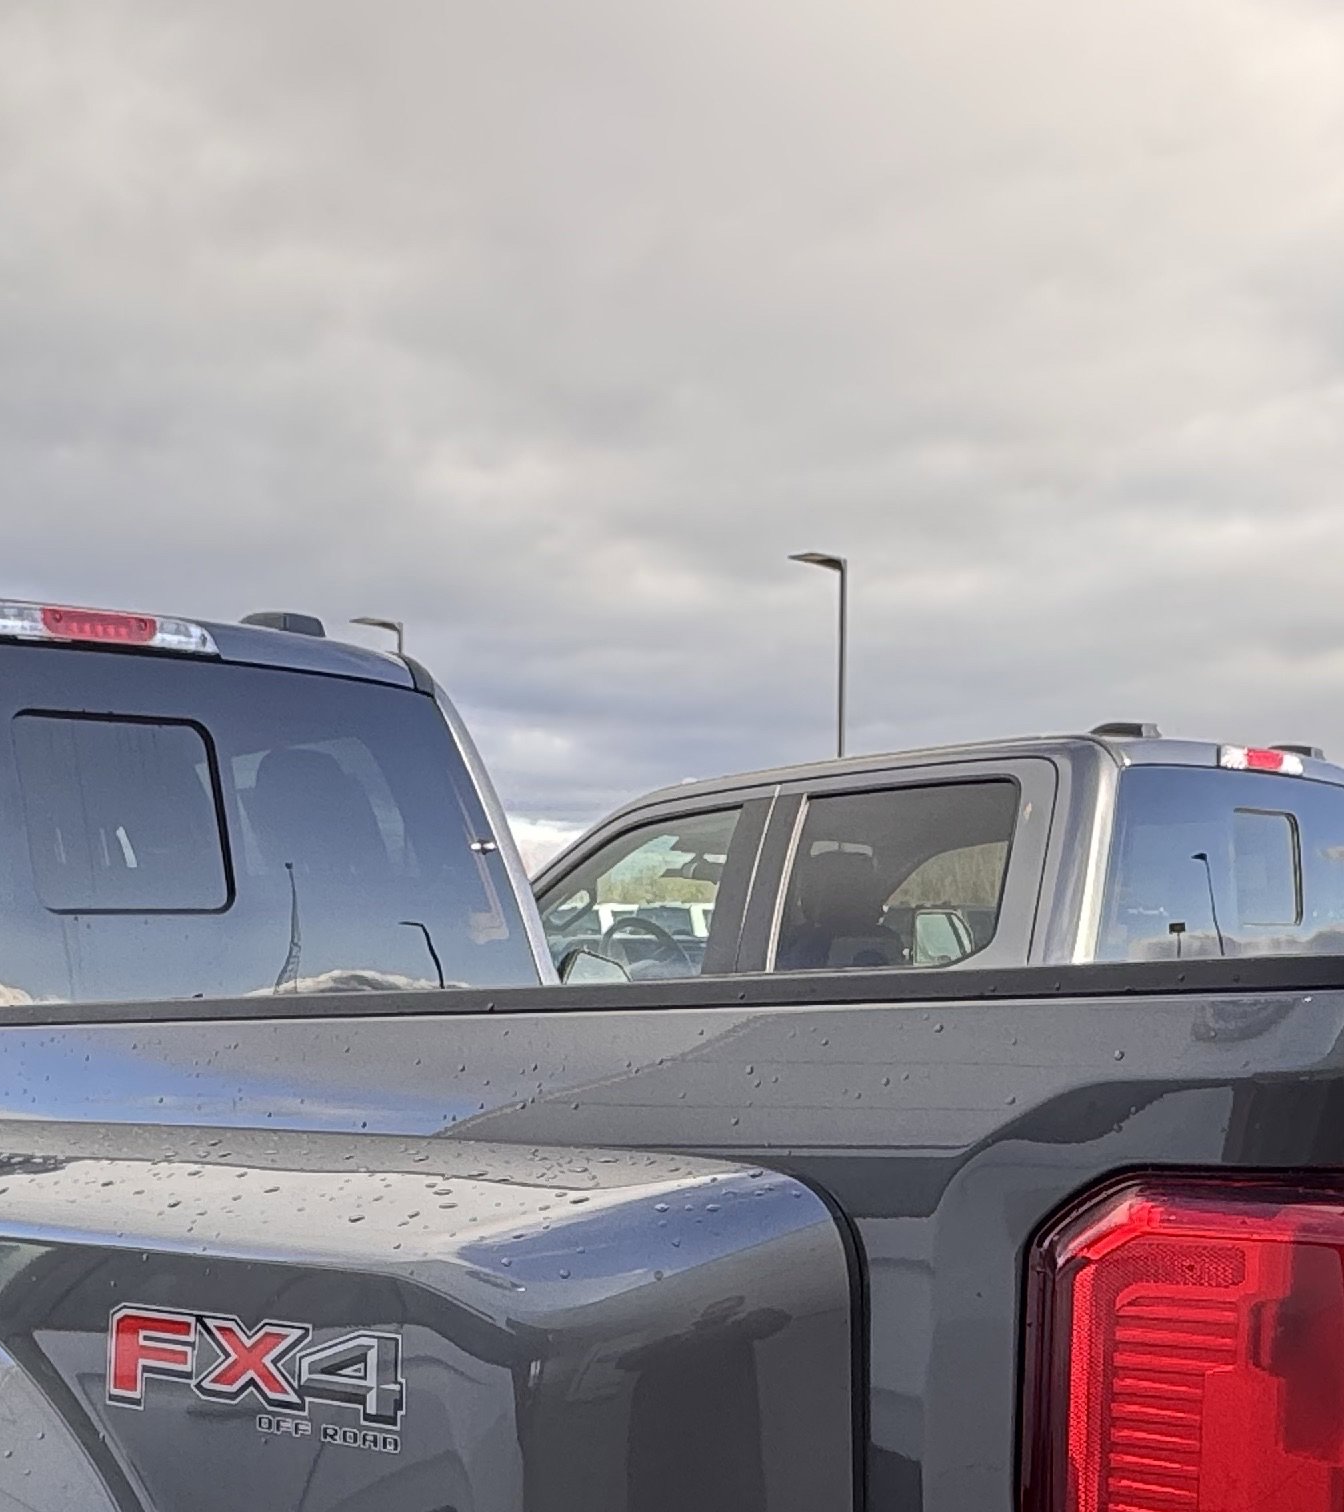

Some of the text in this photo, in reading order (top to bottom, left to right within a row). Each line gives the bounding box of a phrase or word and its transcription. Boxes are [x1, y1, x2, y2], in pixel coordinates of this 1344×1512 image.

[106, 1302, 405, 1431] FX4
[256, 1414, 401, 1453] OFF ROAD
